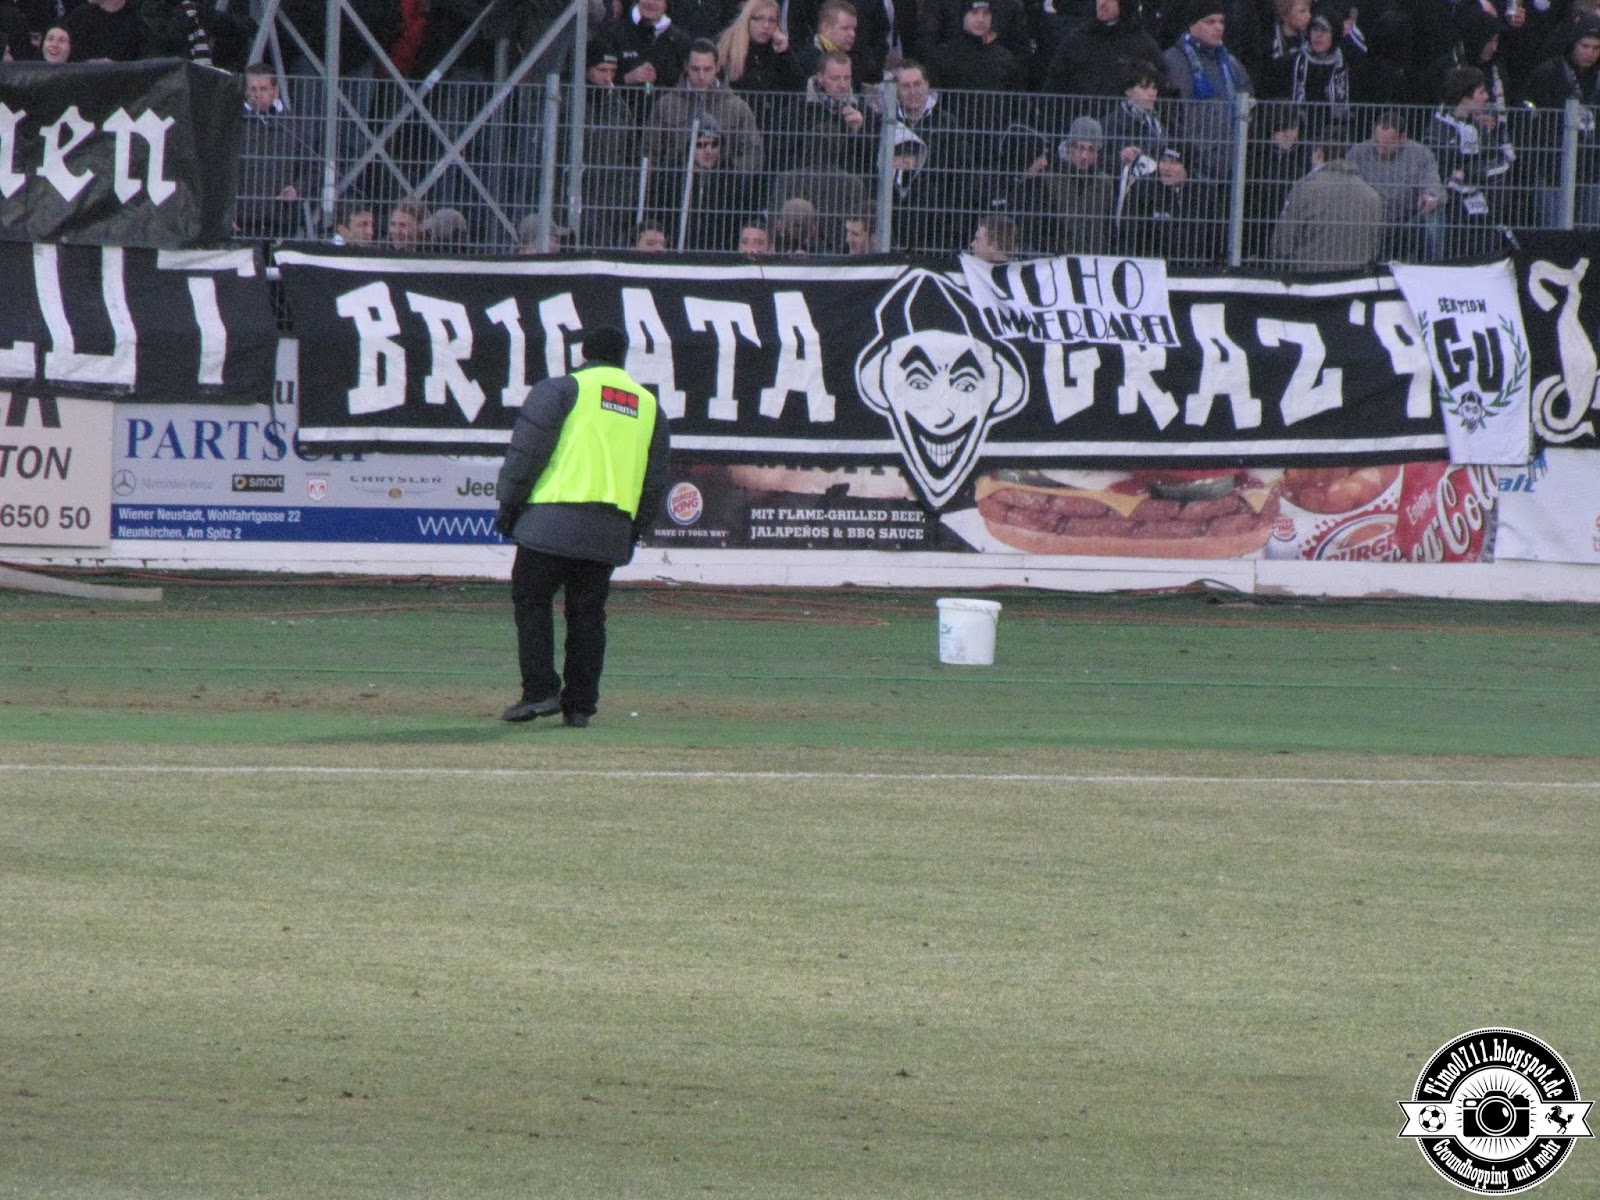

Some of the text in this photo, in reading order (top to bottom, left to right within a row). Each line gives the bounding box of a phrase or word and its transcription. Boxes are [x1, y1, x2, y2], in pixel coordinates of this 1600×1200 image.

[1433, 317, 1504, 393] GU
[602, 401, 638, 416] SECURITAS
[249, 476, 283, 488] smart
[350, 475, 442, 483] CHRYSLER
[673, 498, 699, 514] KING
[58, 506, 90, 529] 50
[119, 508, 154, 521] Wiener
[157, 509, 205, 523] Neustadt,
[287, 510, 301, 523] 22
[750, 509, 925, 523] MIT FLAME-GRILLED BEEF,
[118, 526, 242, 541] Neunkirchen, Am Spitz 2
[417, 516, 503, 542] www.
[654, 529, 676, 537] HAVE
[678, 529, 686, 537] IT
[750, 525, 924, 540] JALAPEÑOS & BBQ SAUCE
